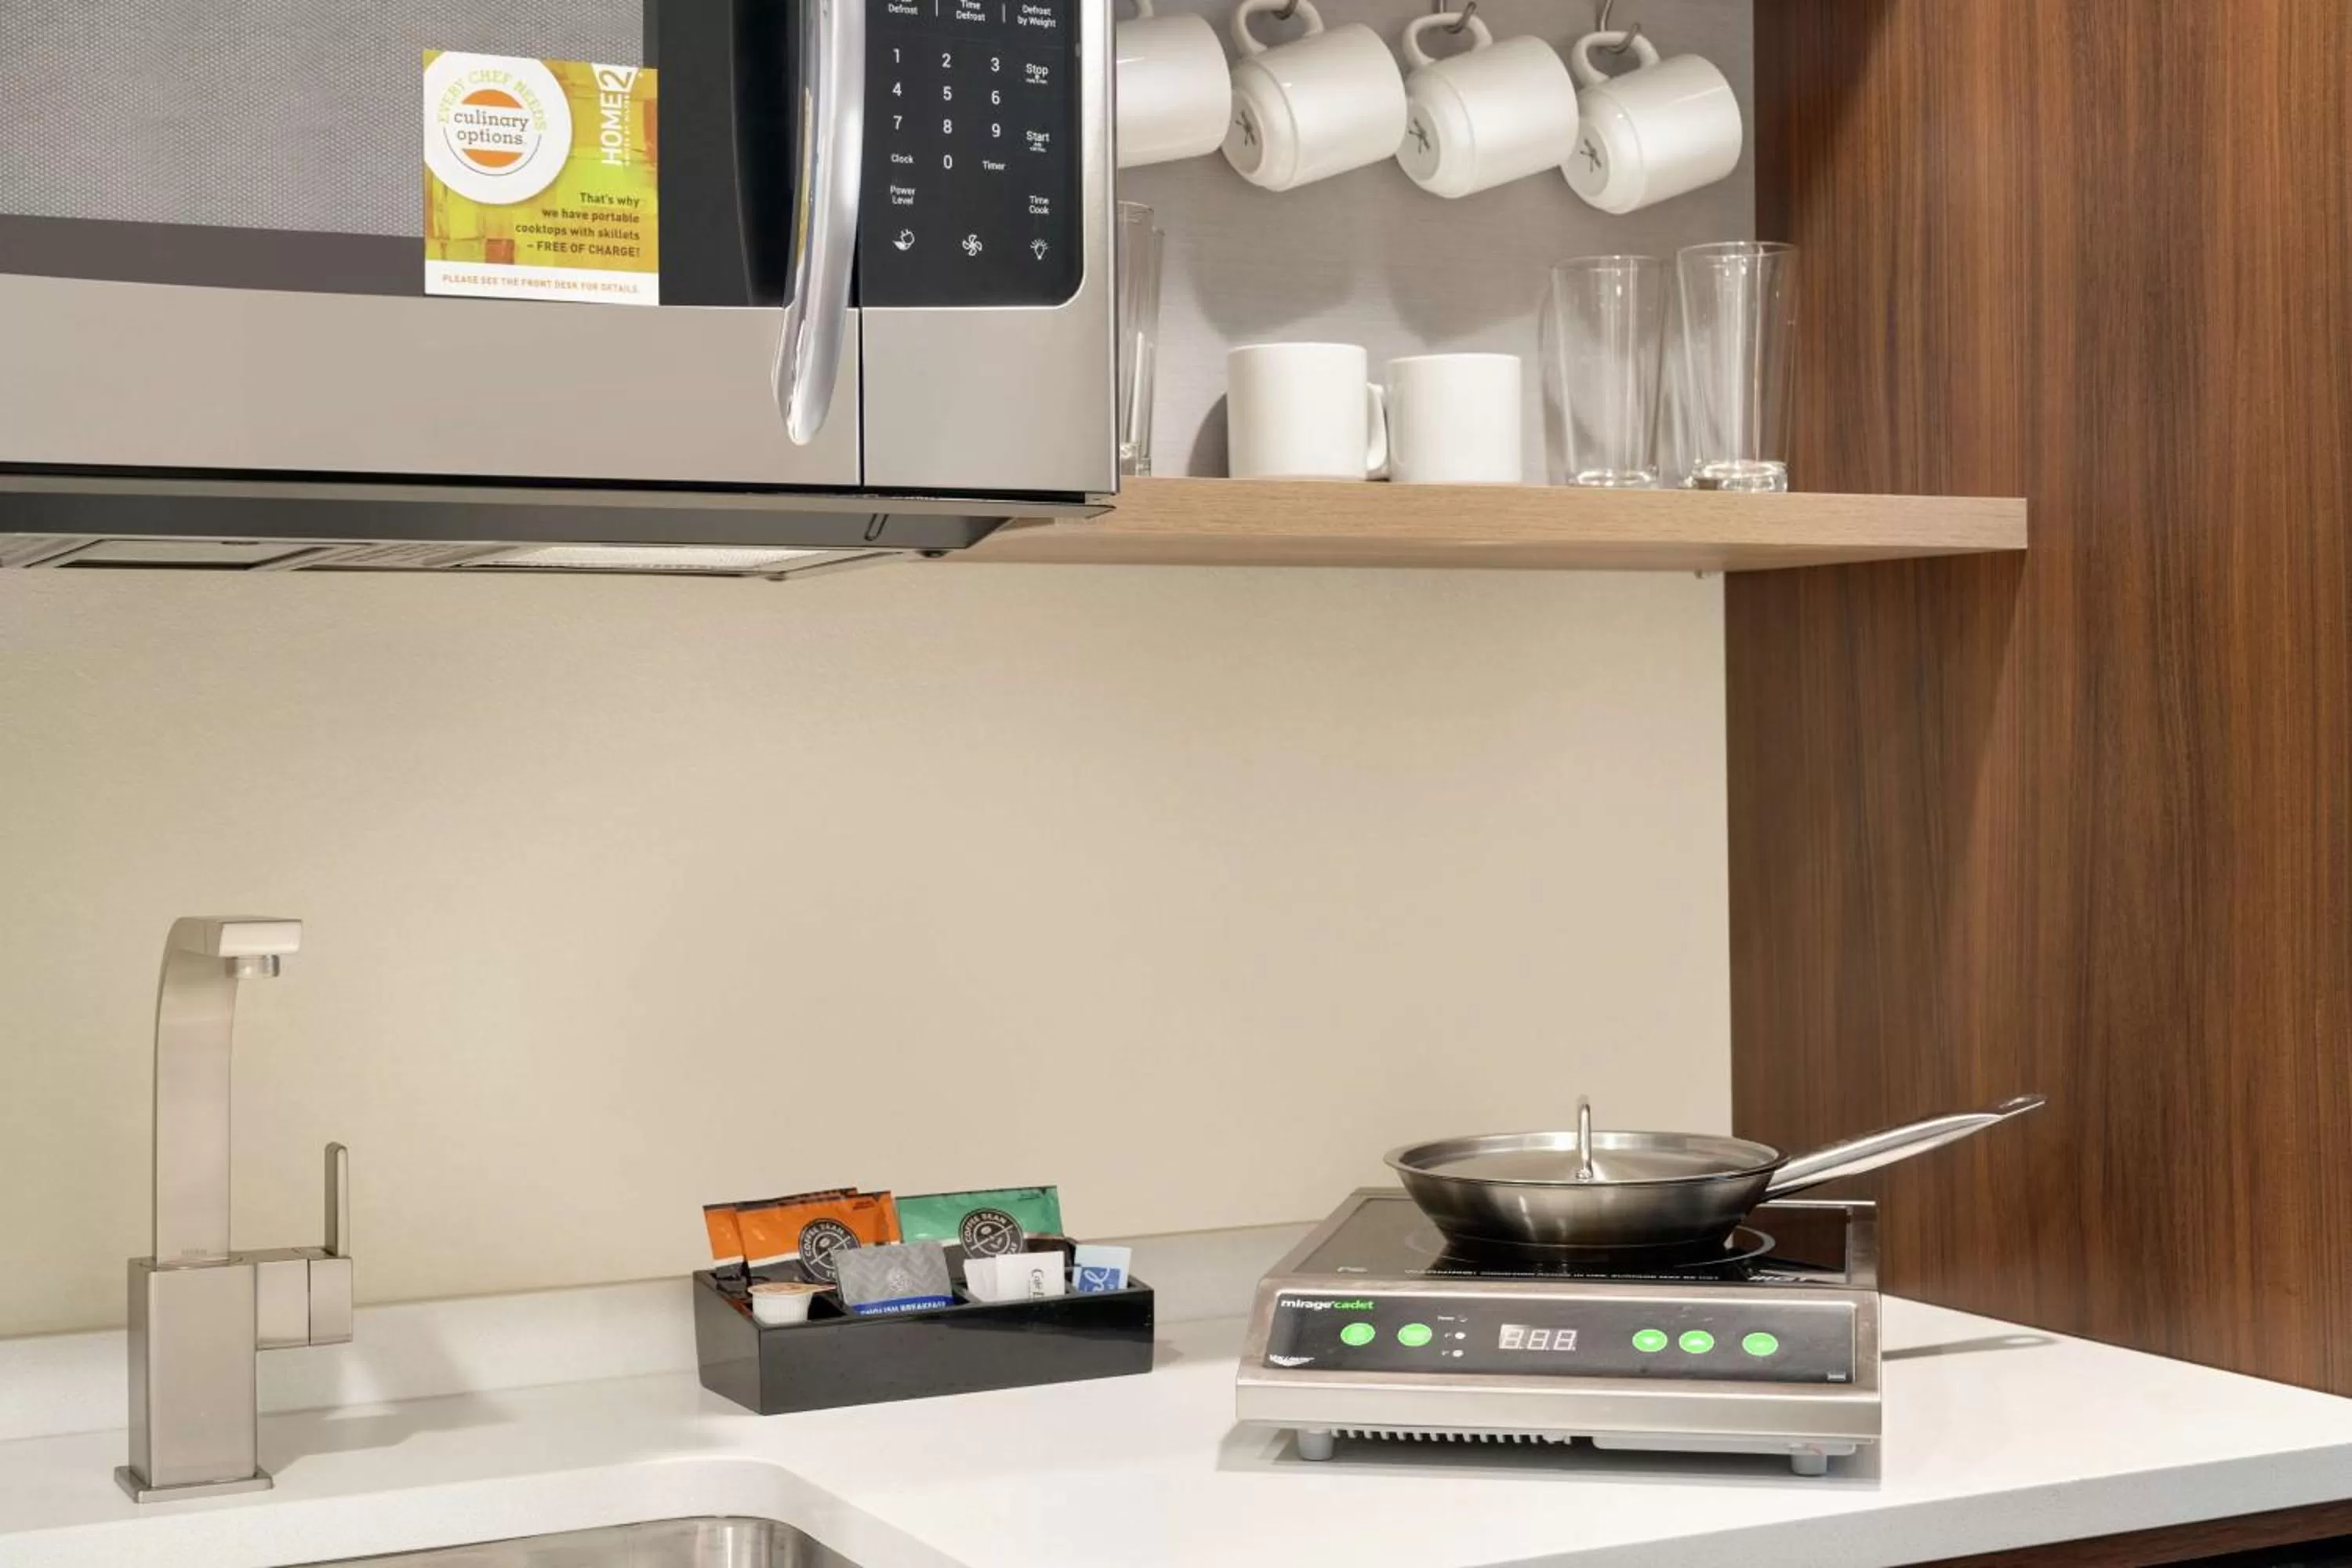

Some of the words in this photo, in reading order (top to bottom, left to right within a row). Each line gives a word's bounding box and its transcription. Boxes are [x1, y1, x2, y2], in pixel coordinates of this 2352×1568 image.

[888, 3, 918, 15] Defrost
[961, 0, 981, 9] Time
[1022, 5, 1051, 16] Defrost
[956, 10, 985, 22] Defrost
[1017, 15, 1028, 24] by
[1029, 17, 1057, 28] Weight
[893, 48, 901, 64] 1
[942, 53, 951, 68] 2
[991, 57, 1000, 72] 3
[1025, 63, 1049, 78] Stop
[468, 69, 513, 85] CHEF
[892, 82, 902, 97] 4
[943, 86, 952, 101] 5
[991, 90, 1000, 105] 6
[454, 109, 531, 132] culinary
[893, 115, 902, 130] 7
[943, 119, 953, 134] 8
[456, 128, 524, 145] options
[991, 123, 1001, 138] 9
[1025, 130, 1050, 143] Start
[891, 153, 914, 164] Clock
[943, 154, 953, 169] 0
[982, 160, 1006, 171] Timer
[890, 185, 916, 195] Power
[580, 192, 614, 205] That's
[616, 196, 640, 209] why
[891, 196, 914, 205] Level
[1029, 196, 1049, 205] Time
[542, 209, 559, 218] we
[561, 208, 589, 220] have
[591, 211, 641, 224] portable
[1029, 205, 1050, 215] Cook
[515, 223, 567, 237] cooktops
[570, 226, 595, 237] with
[598, 228, 641, 241] skillets
[536, 241, 568, 253] FREE
[570, 243, 586, 253] OF
[588, 244, 641, 258] CHARGE!
[441, 274, 478, 285] PLEASE
[501, 277, 519, 287] THE
[521, 278, 552, 289] FRONT
